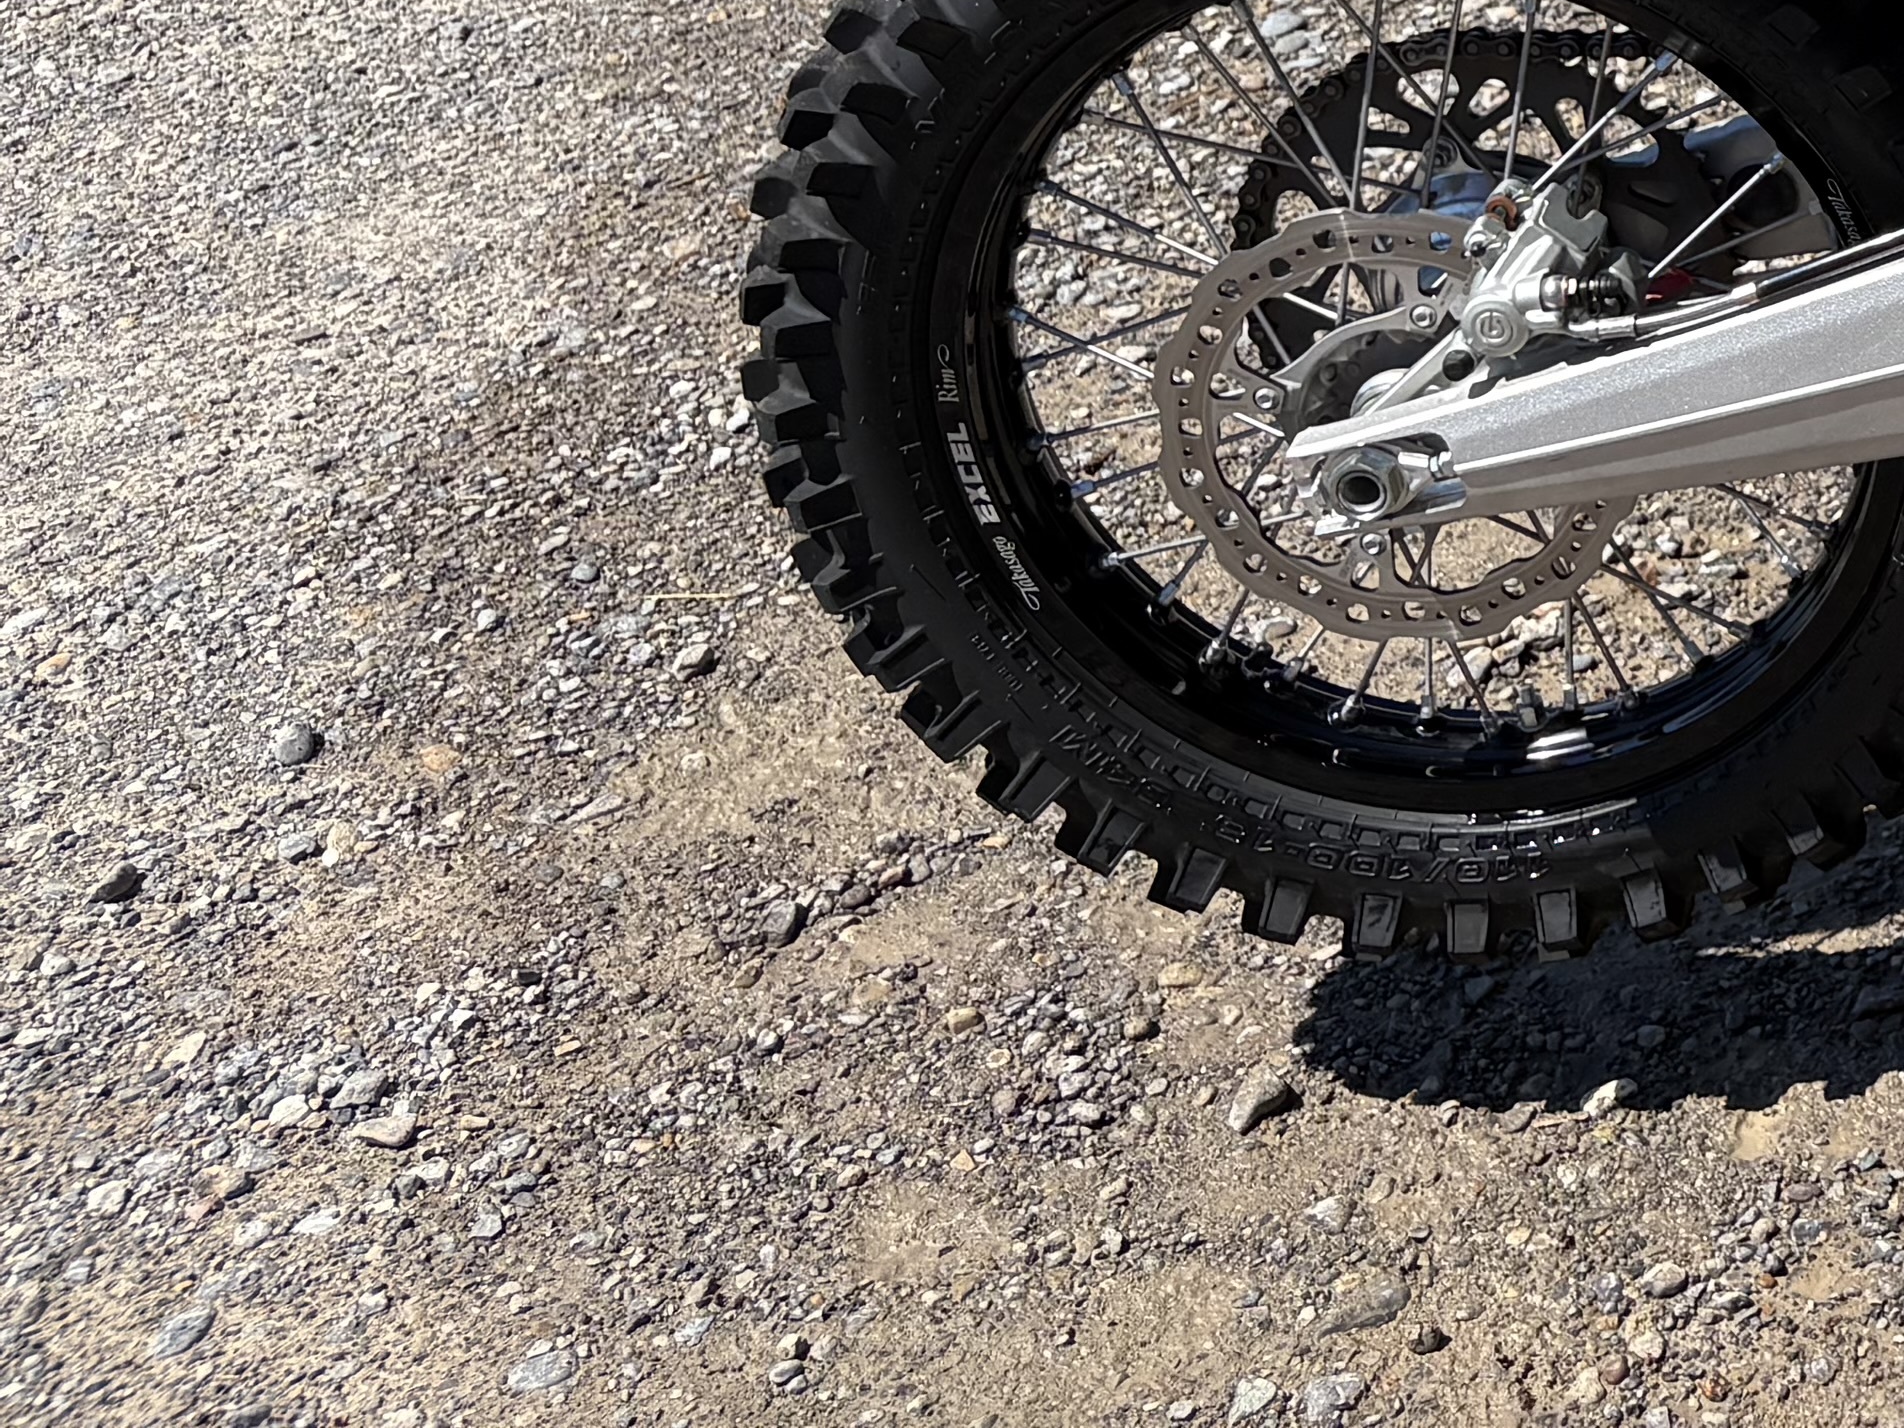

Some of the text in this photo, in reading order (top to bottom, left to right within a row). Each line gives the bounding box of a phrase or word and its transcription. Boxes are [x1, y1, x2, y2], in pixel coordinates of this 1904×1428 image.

[1826, 178, 1861, 245] Takasa
[936, 344, 960, 403] Rim
[946, 422, 1001, 526] EXCEL
[992, 536, 1040, 611] Takasago
